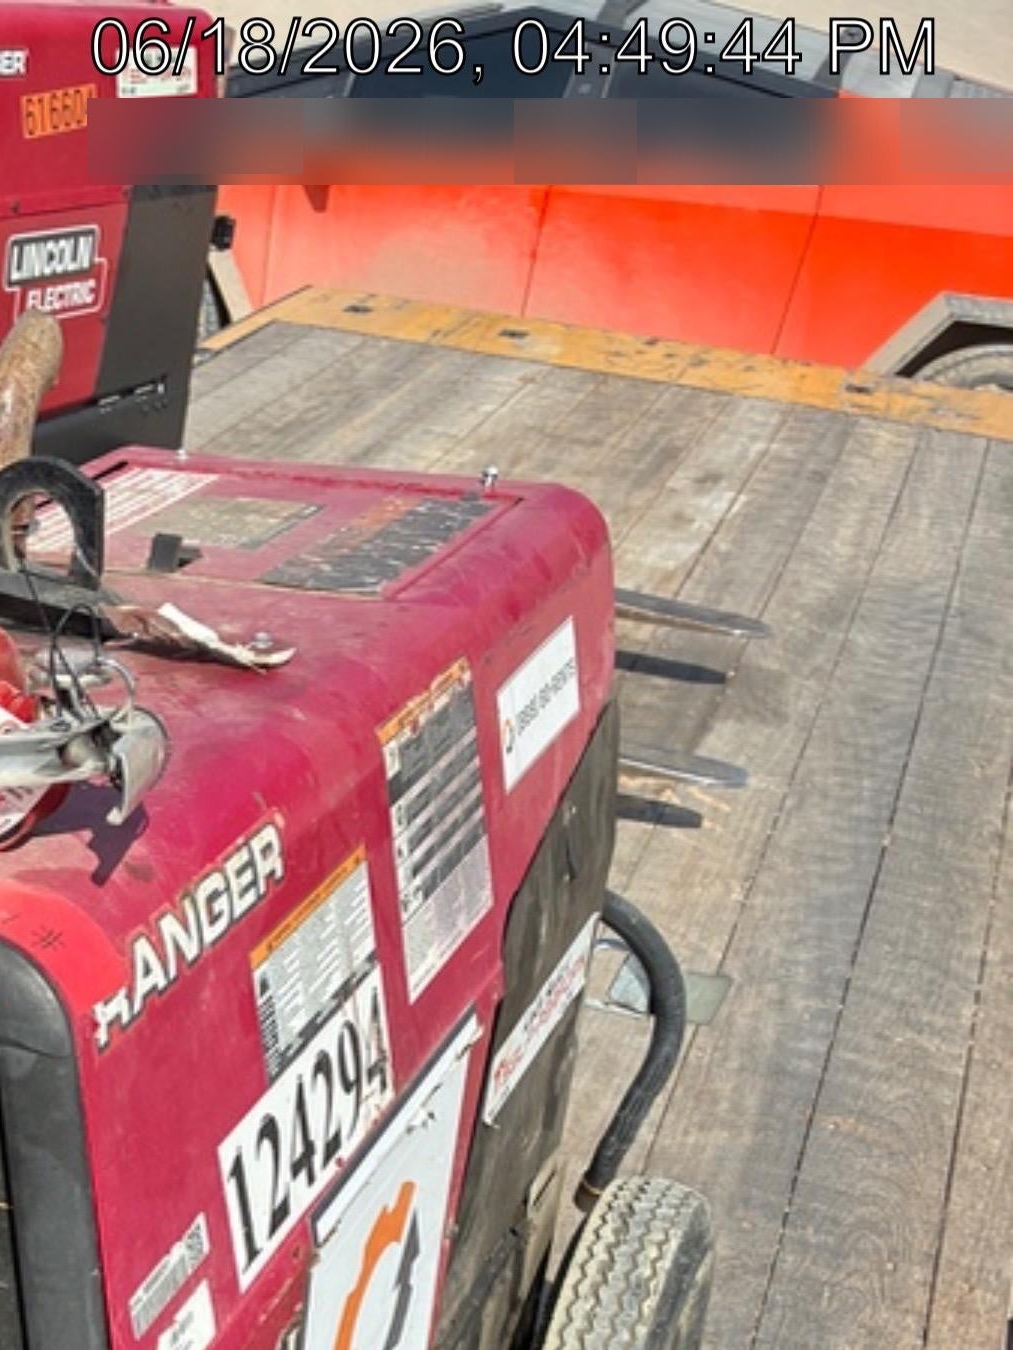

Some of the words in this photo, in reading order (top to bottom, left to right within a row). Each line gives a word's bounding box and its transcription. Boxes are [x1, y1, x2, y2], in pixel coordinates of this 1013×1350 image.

[24, 87, 95, 137] 61660
[10, 235, 93, 282] LINCOLN
[28, 278, 96, 312] ELECTRIC
[225, 985, 391, 1271] 124294
